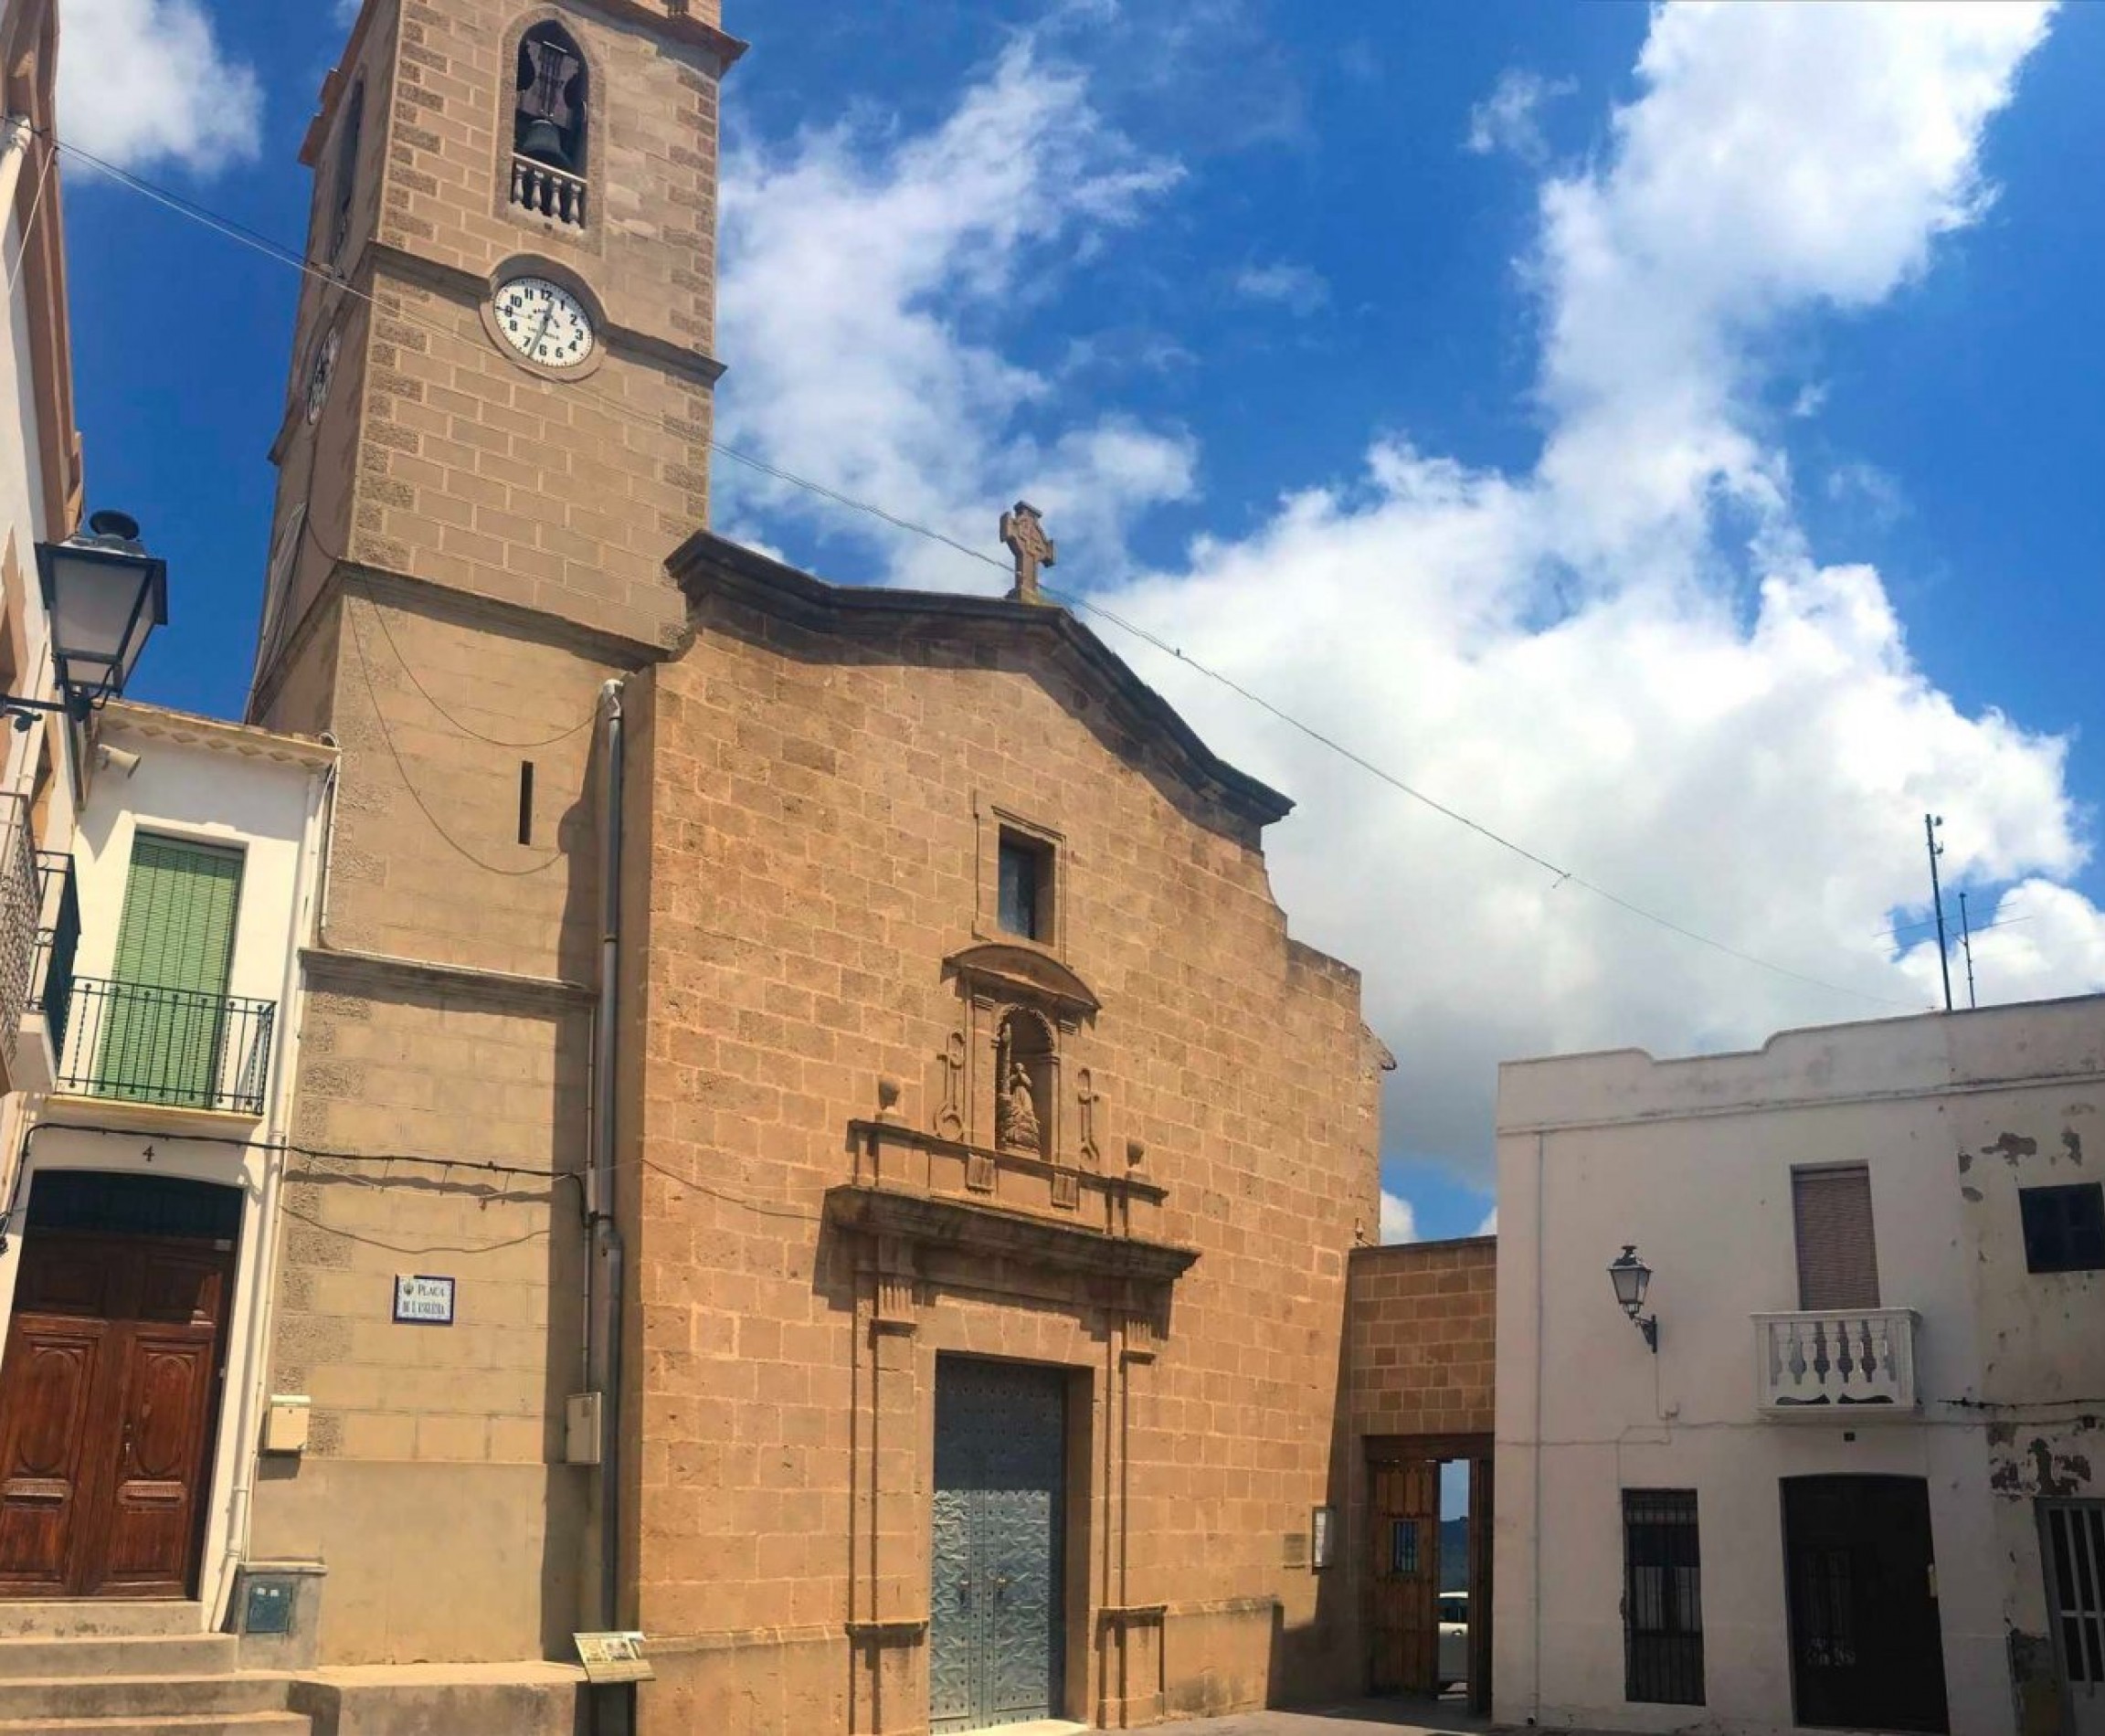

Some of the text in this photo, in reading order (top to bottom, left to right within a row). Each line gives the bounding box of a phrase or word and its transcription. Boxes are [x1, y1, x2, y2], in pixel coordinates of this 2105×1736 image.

[524, 288, 534, 301] 11
[541, 289, 553, 301] 12
[511, 294, 522, 308] 10
[504, 305, 513, 317] 9
[570, 313, 577, 326] 2
[509, 320, 517, 332] 8
[575, 329, 584, 341] 3
[523, 335, 531, 348] 7
[568, 341, 576, 351] 4
[539, 344, 546, 355] 6
[556, 347, 563, 357] 5
[143, 1146, 154, 1161] 4
